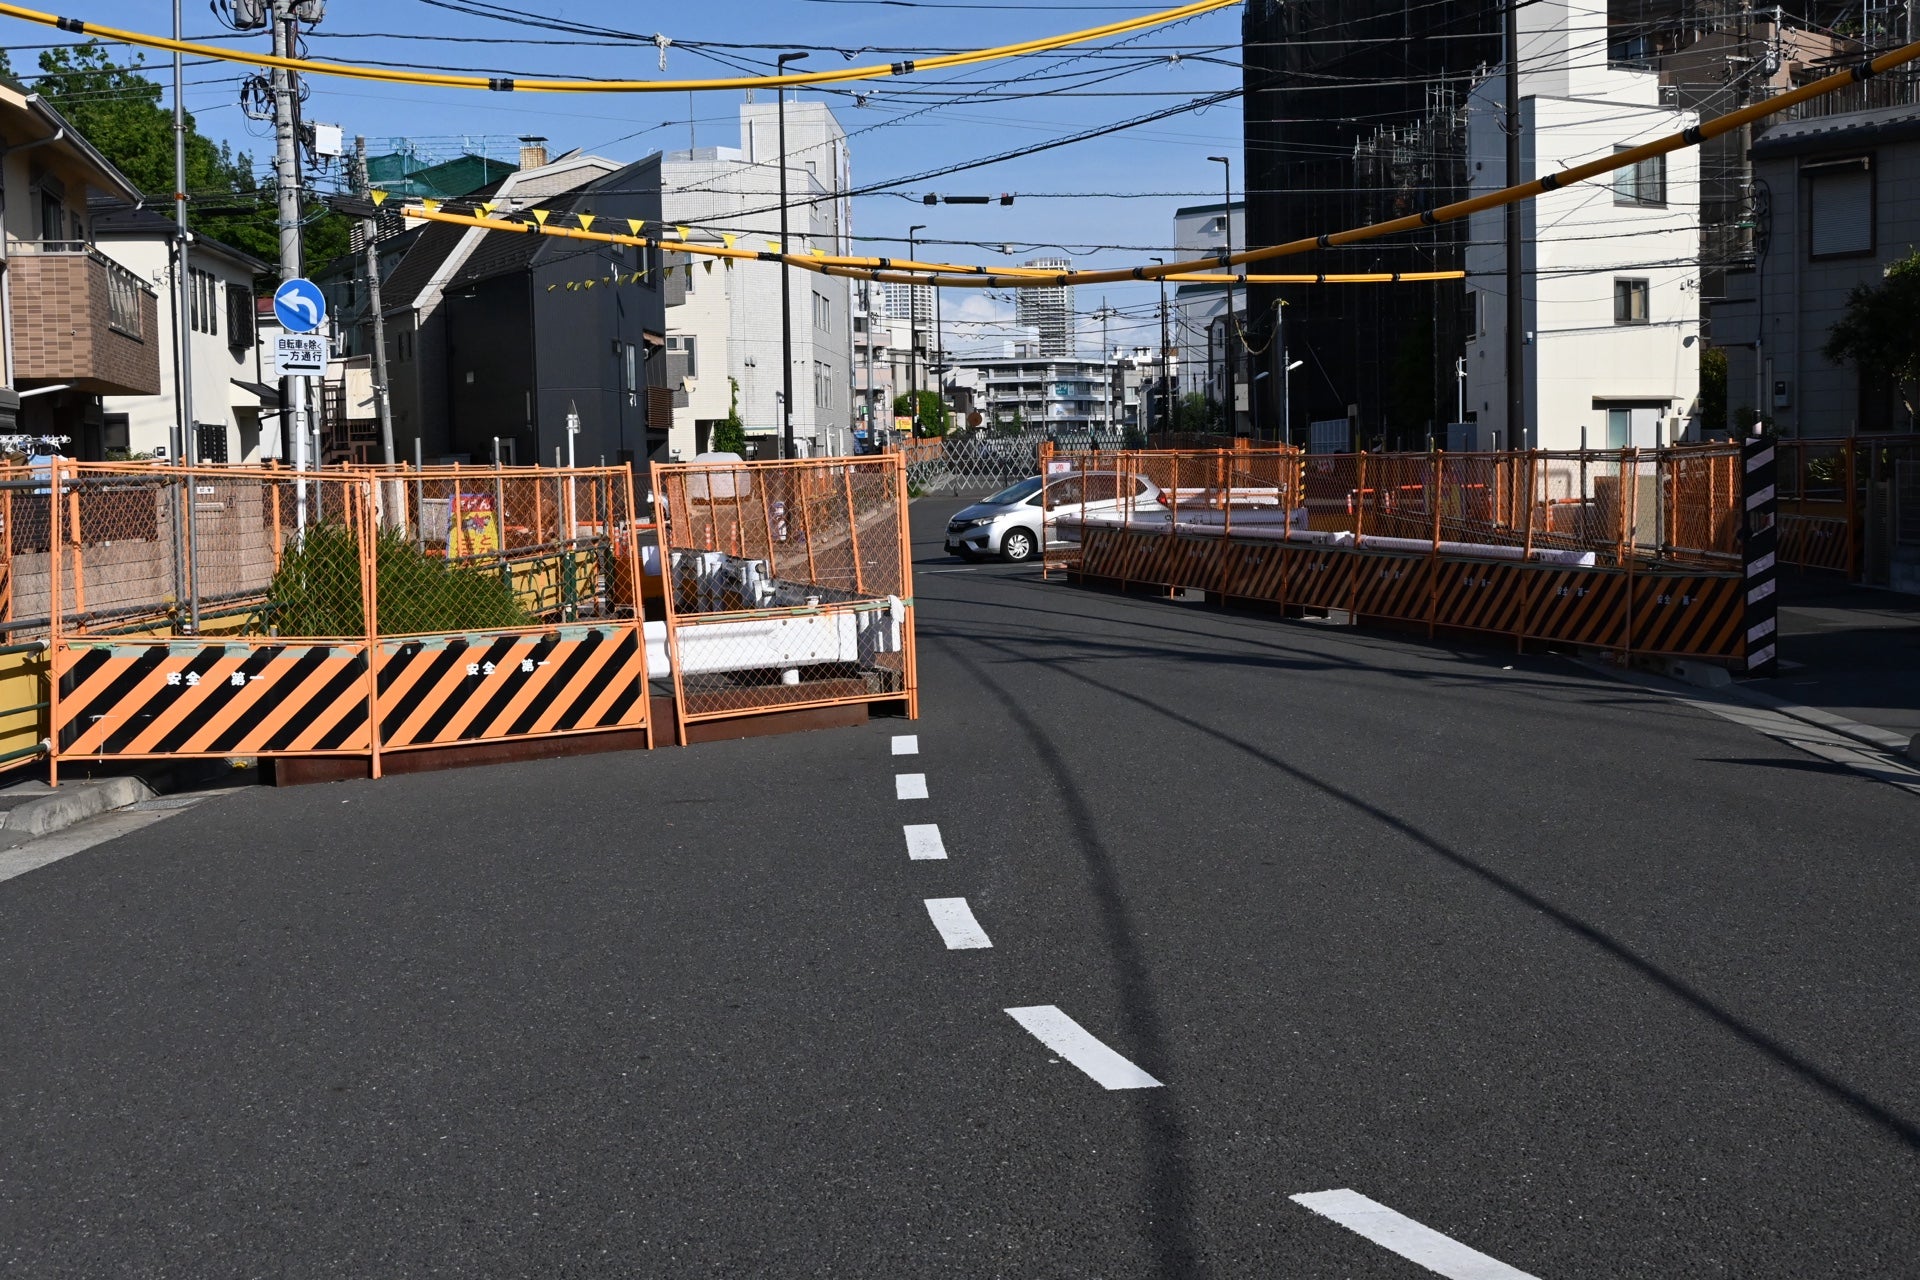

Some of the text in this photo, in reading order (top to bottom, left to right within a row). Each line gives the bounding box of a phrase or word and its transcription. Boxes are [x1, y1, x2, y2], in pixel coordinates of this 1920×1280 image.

[279, 339, 322, 350] 自転車を除く
[279, 351, 322, 362] 一方通行
